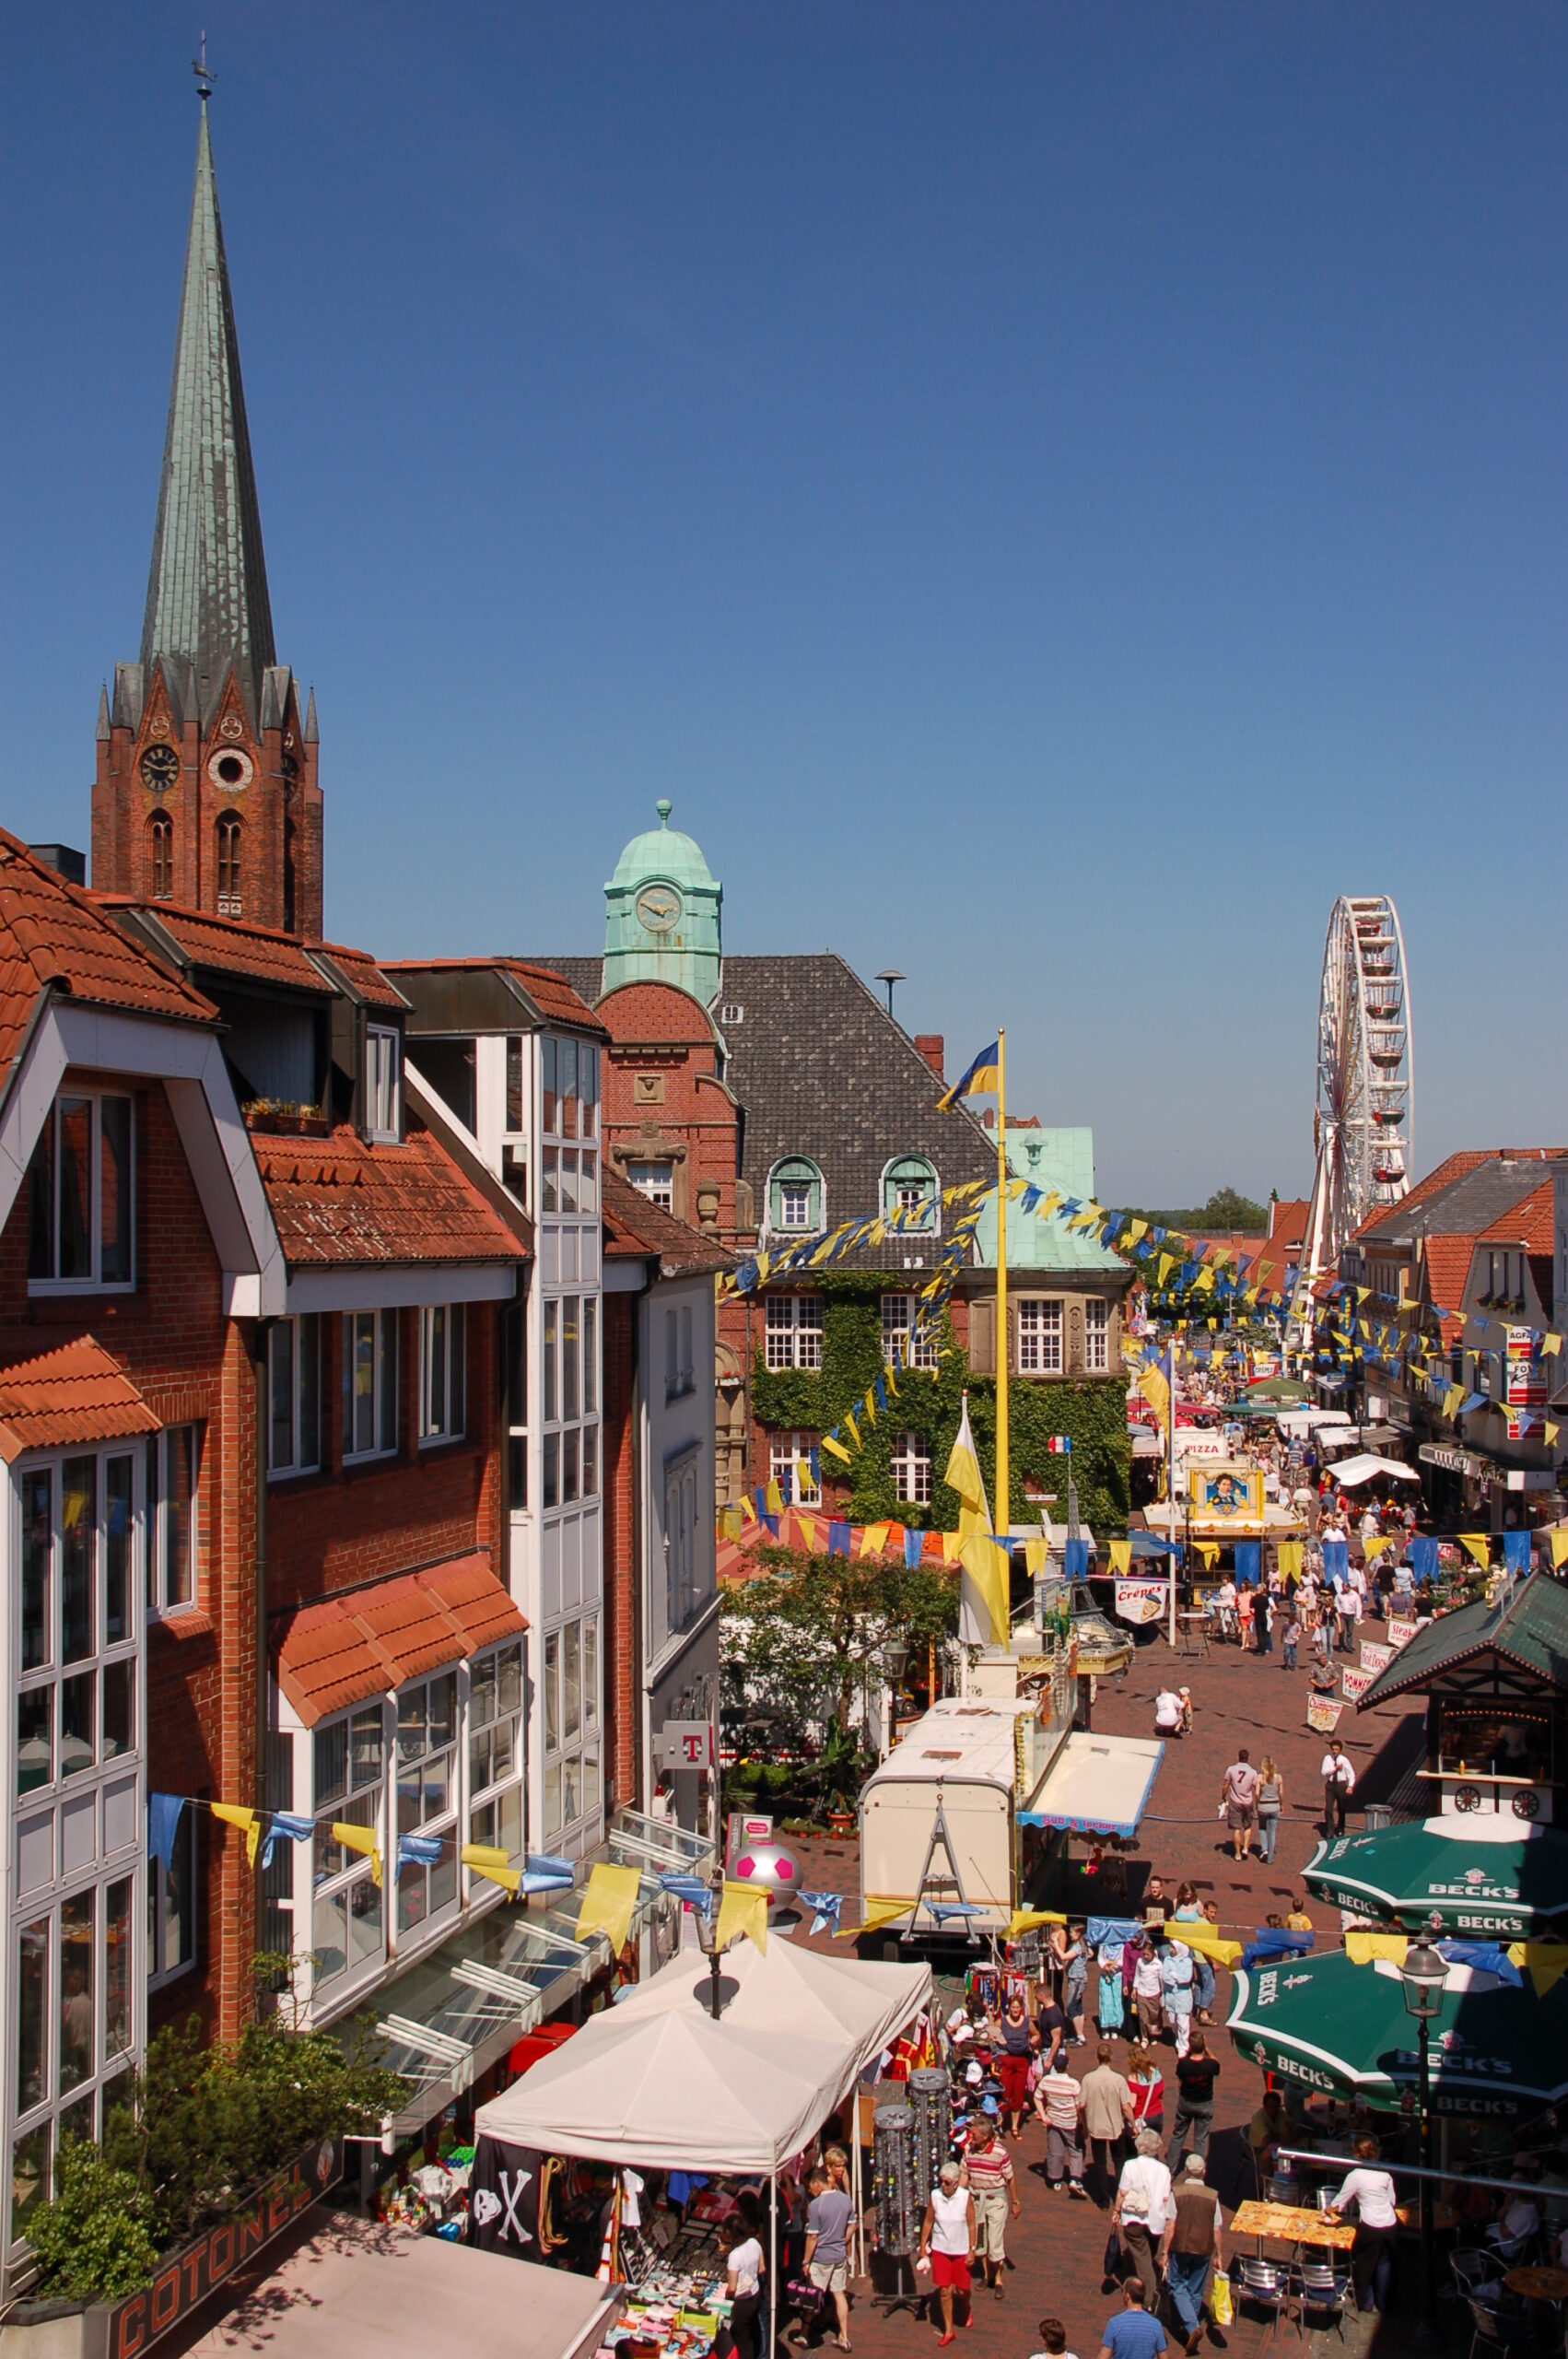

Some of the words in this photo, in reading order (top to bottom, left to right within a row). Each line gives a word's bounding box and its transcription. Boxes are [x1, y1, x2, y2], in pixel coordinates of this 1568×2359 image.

[1186, 1445, 1219, 1453] PIZZA
[1117, 1585, 1163, 1602] Crêpes
[683, 1735, 702, 1762] T
[1428, 1884, 1520, 1899] BECK'S
[1457, 1915, 1523, 1931] BECK'S
[1397, 2049, 1512, 2073] BECK'S
[1277, 2054, 1335, 2090] BECK'S
[1437, 2095, 1518, 2114] BECK'S
